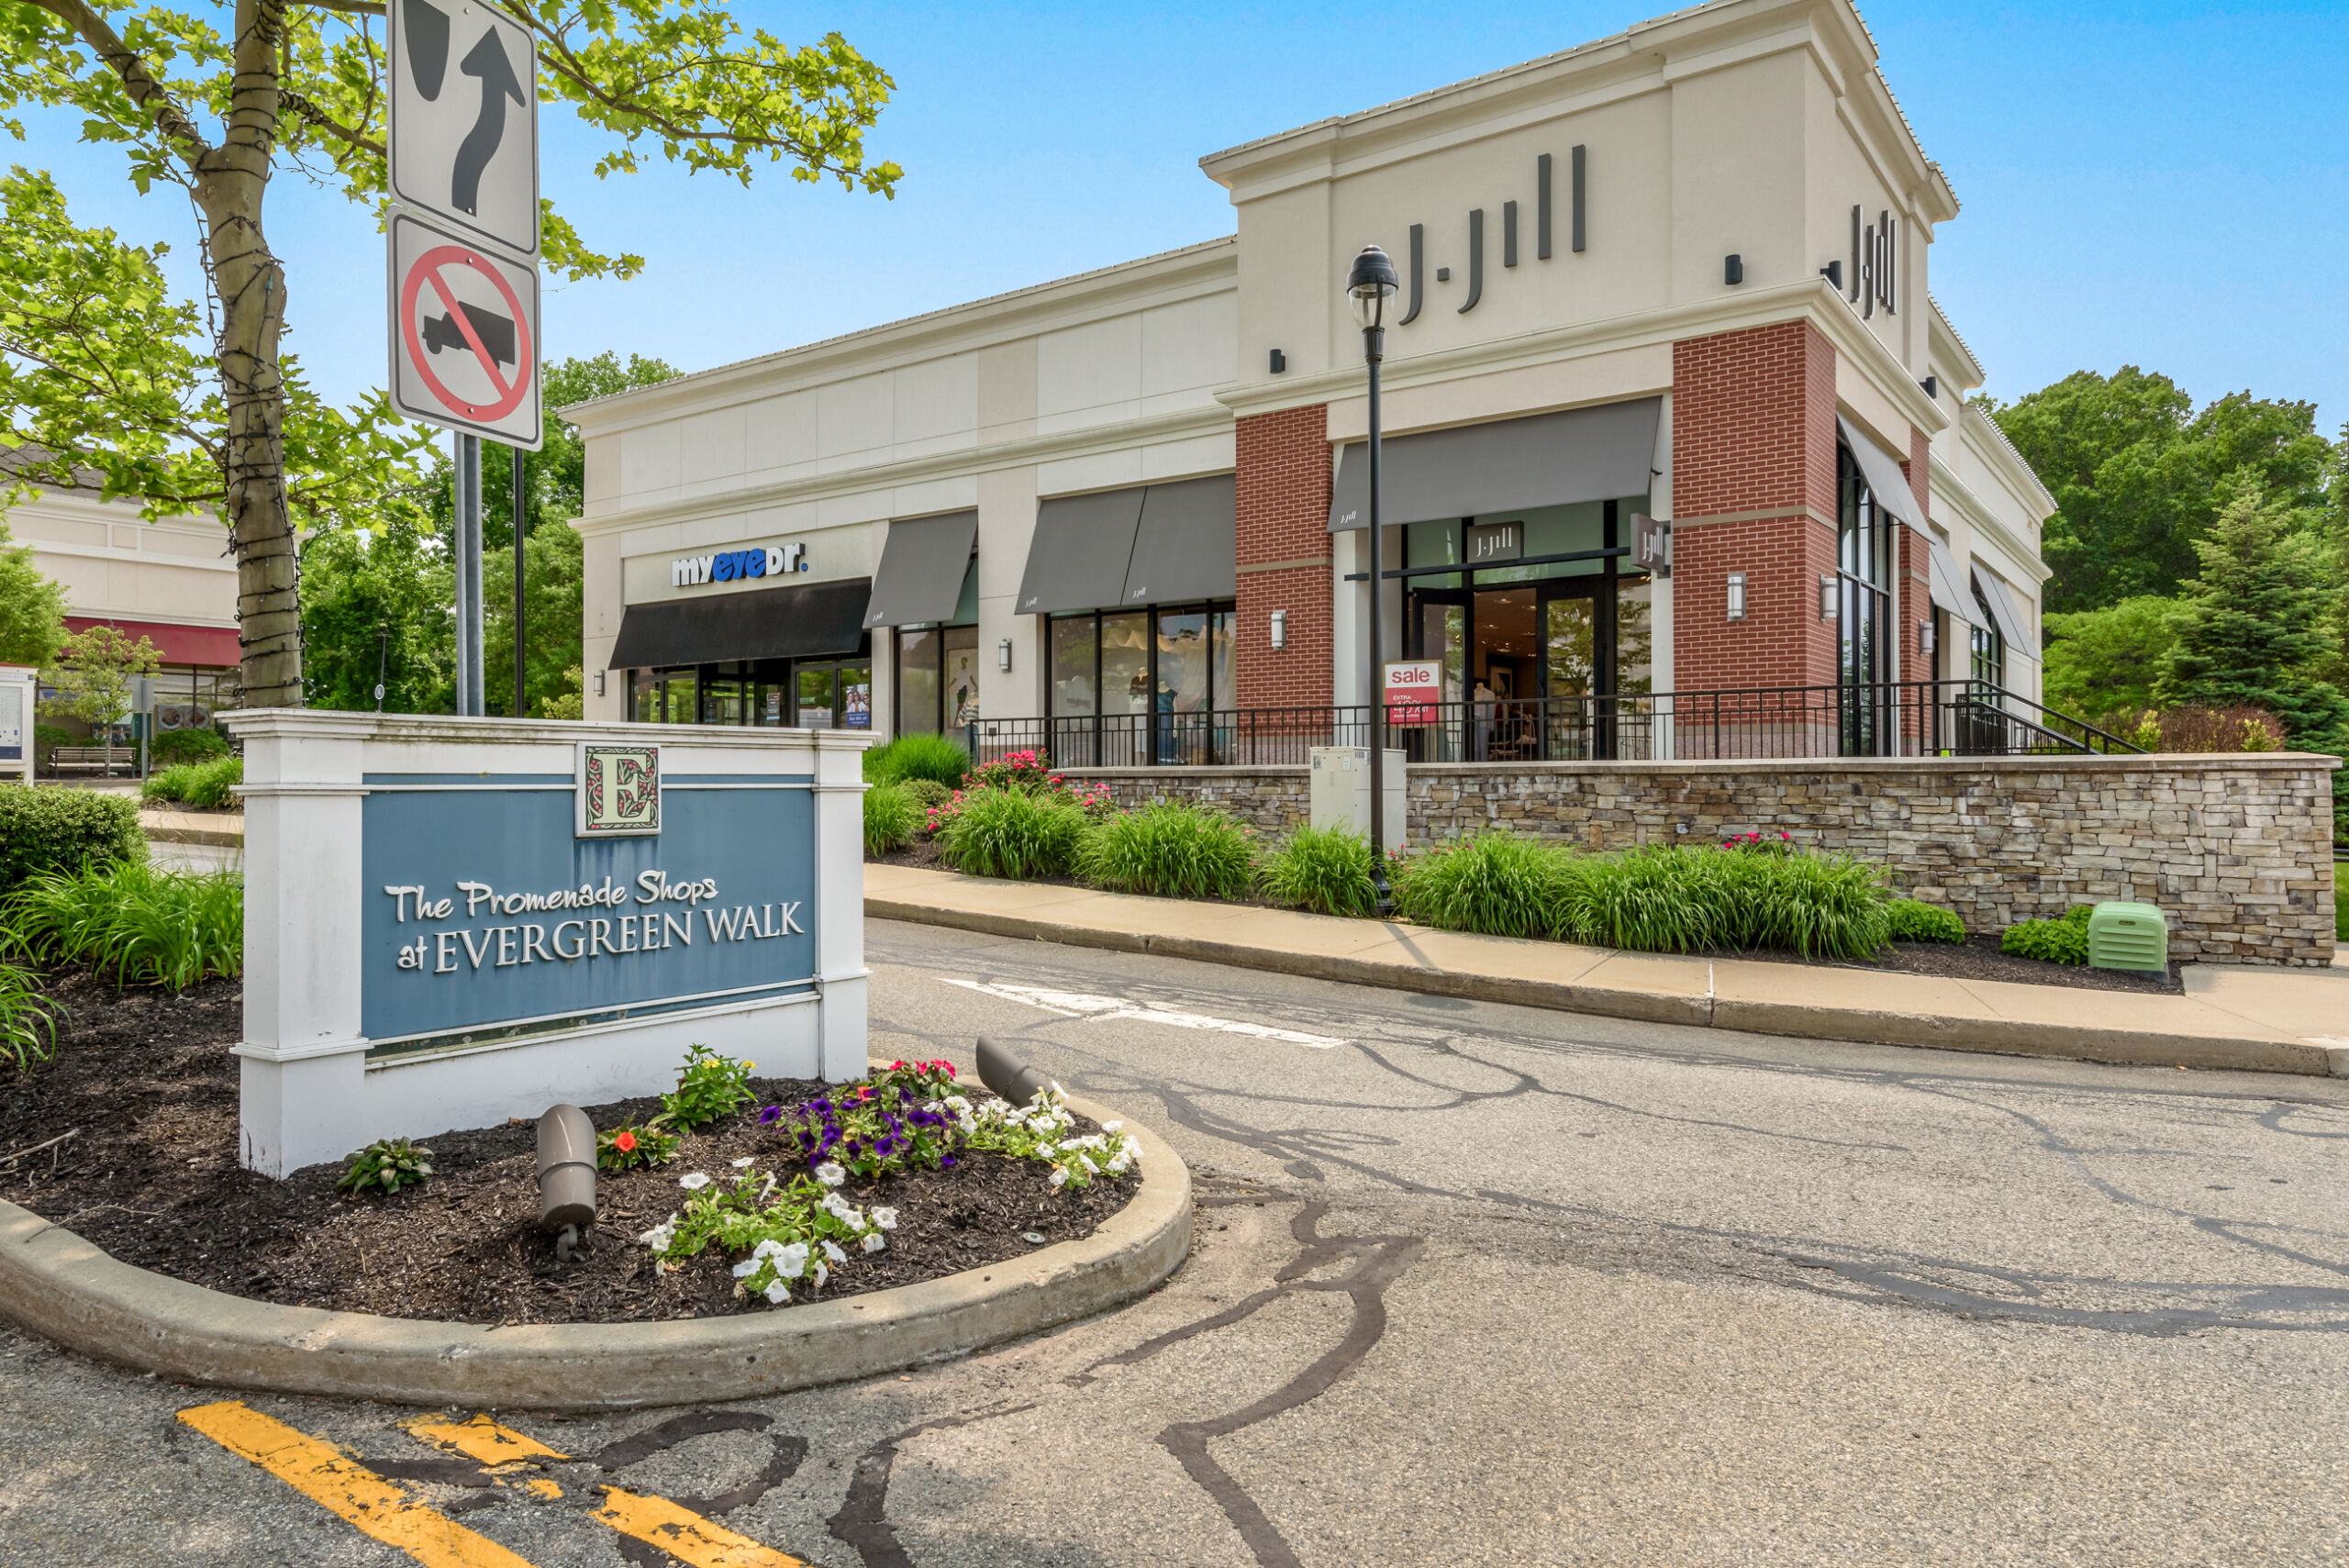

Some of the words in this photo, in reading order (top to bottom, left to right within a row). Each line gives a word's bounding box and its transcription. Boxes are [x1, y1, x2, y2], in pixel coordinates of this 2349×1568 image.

[1391, 667, 1431, 684] sale
[592, 752, 653, 825] E
[384, 884, 454, 922] The
[457, 875, 628, 917] Promenade
[635, 870, 718, 906] Shops
[396, 935, 428, 970] at
[434, 911, 693, 974] EVERGREEN
[703, 900, 806, 944] WALK
